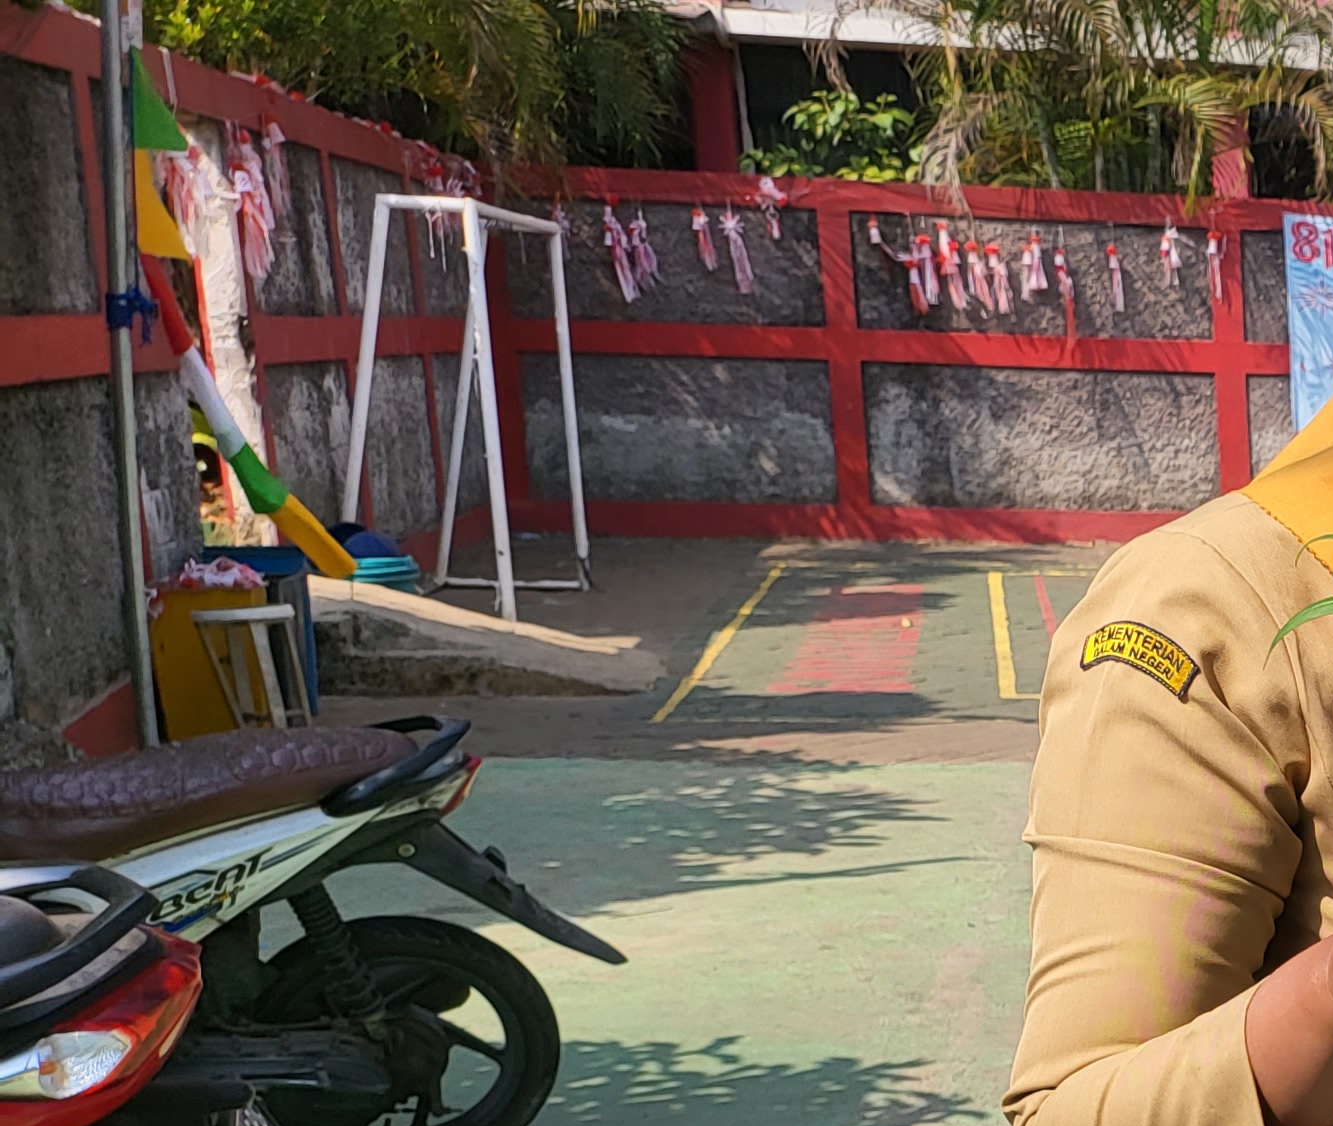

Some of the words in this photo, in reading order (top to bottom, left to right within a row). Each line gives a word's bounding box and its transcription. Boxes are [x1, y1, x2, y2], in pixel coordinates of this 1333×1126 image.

[1093, 626, 1185, 673] KEMENTERIAN
[1093, 642, 1124, 658] DALAM
[1128, 647, 1175, 680] NEGERI
